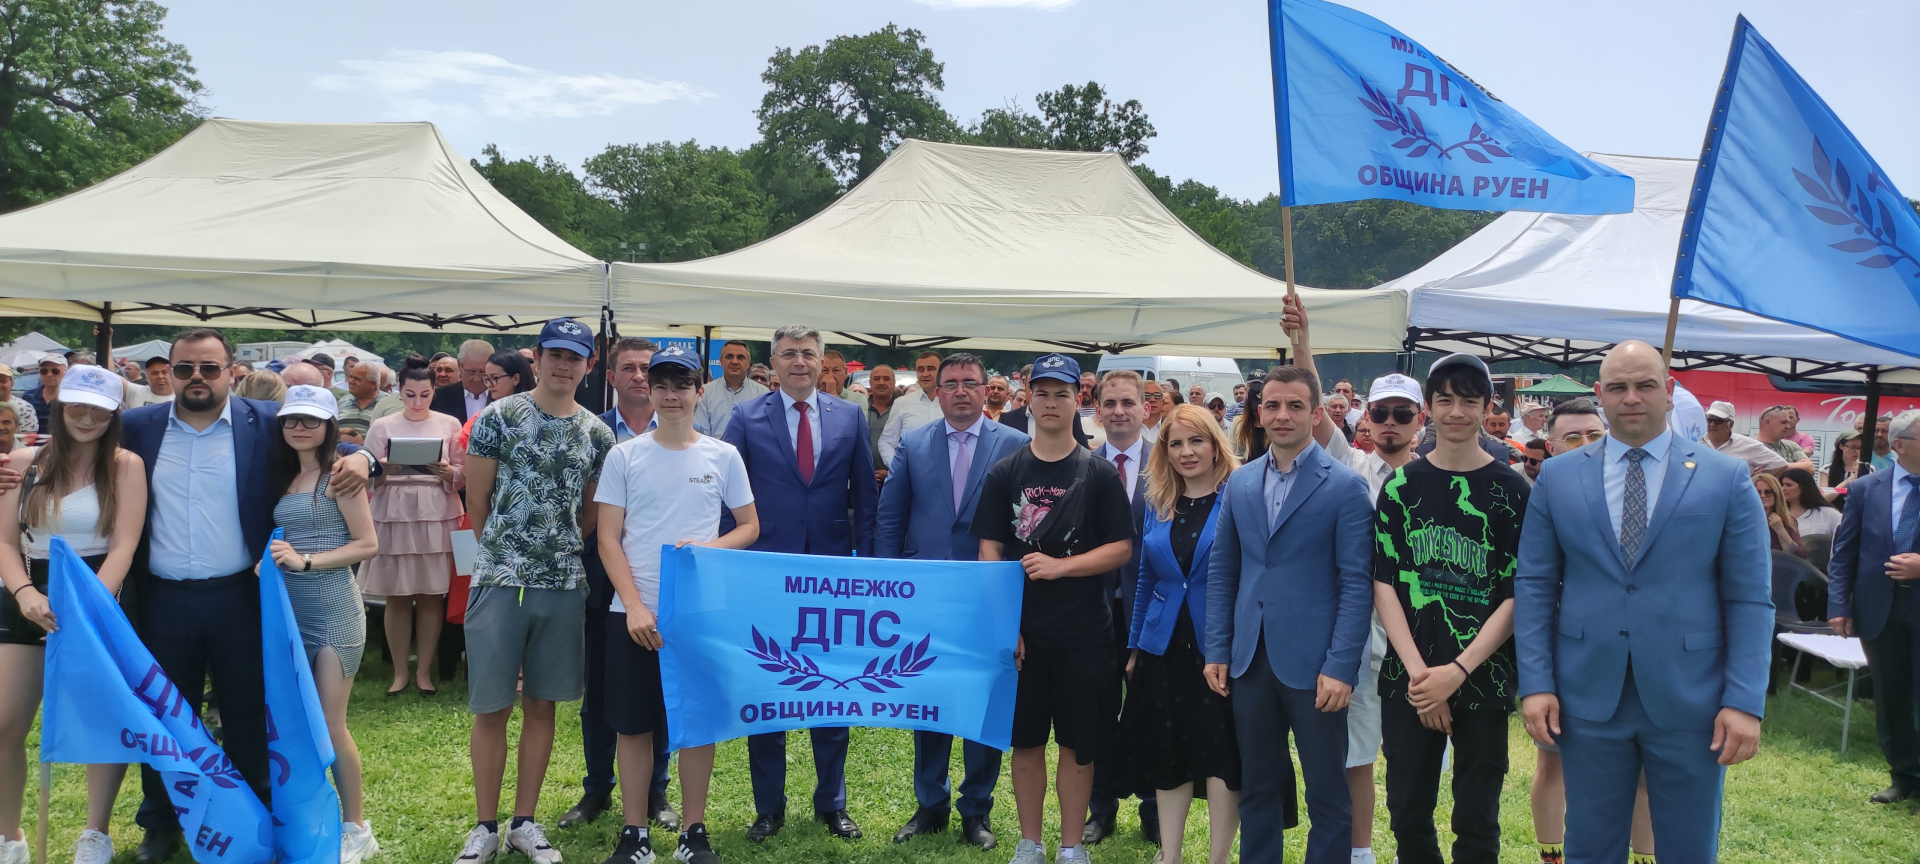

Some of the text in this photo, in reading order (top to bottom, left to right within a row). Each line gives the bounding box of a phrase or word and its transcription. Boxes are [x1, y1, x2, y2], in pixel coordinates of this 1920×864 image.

[1358, 165, 1549, 199] ОБЩИНА РУЕН
[87, 372, 103, 380] ДПС
[1024, 486, 1046, 501] RICK
[785, 576, 915, 598] МЛАДЕЖКО
[791, 607, 901, 652] ДПС
[740, 701, 939, 723] ОБЩИНА РУЕН
